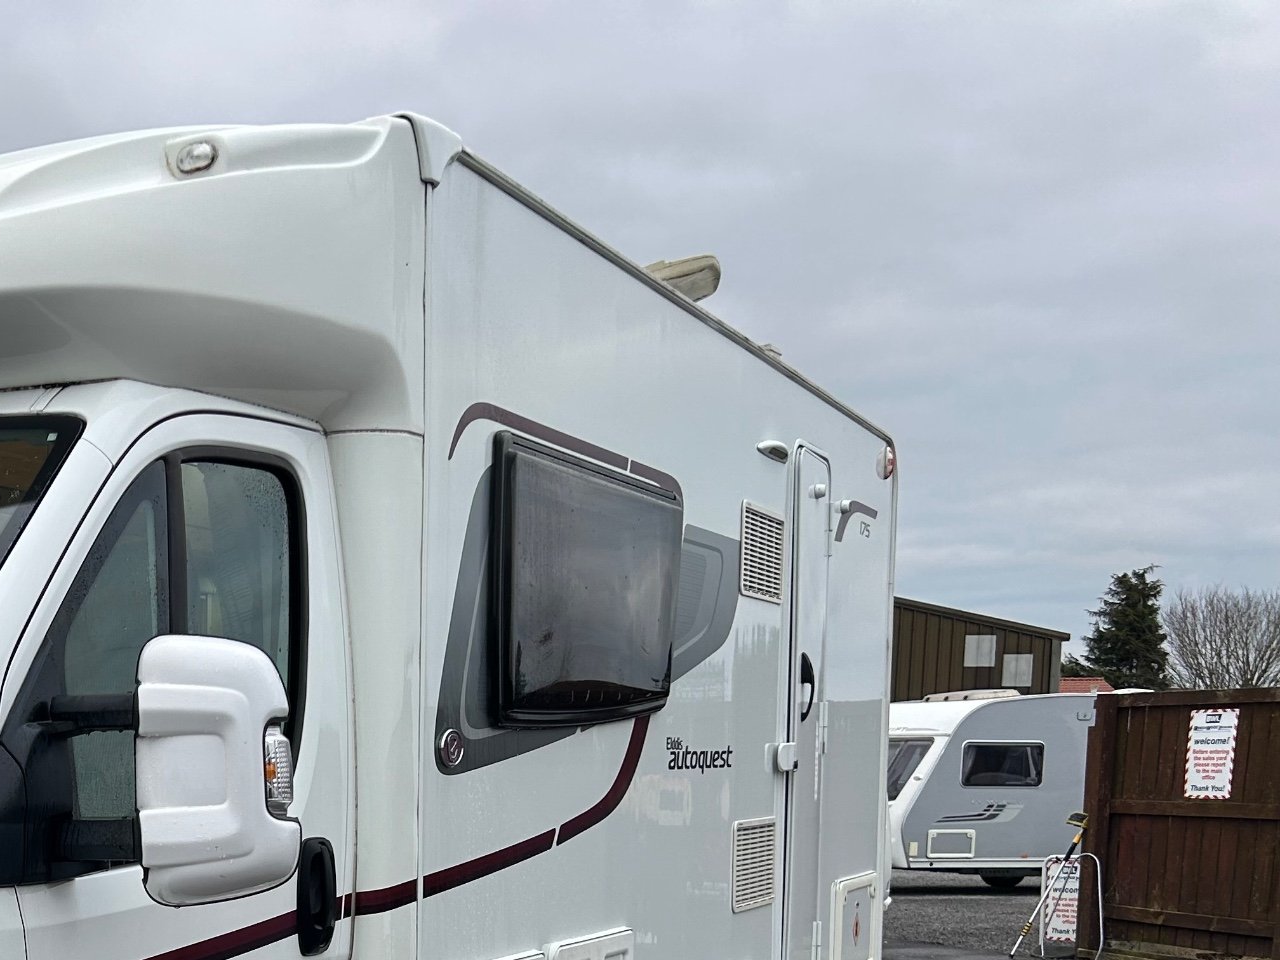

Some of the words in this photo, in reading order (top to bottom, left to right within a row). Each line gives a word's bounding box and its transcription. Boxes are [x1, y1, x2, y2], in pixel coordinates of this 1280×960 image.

[859, 520, 871, 538] 175
[666, 736, 683, 750] Elddis
[1194, 736, 1231, 745] welcome!
[668, 745, 733, 774] autoquest
